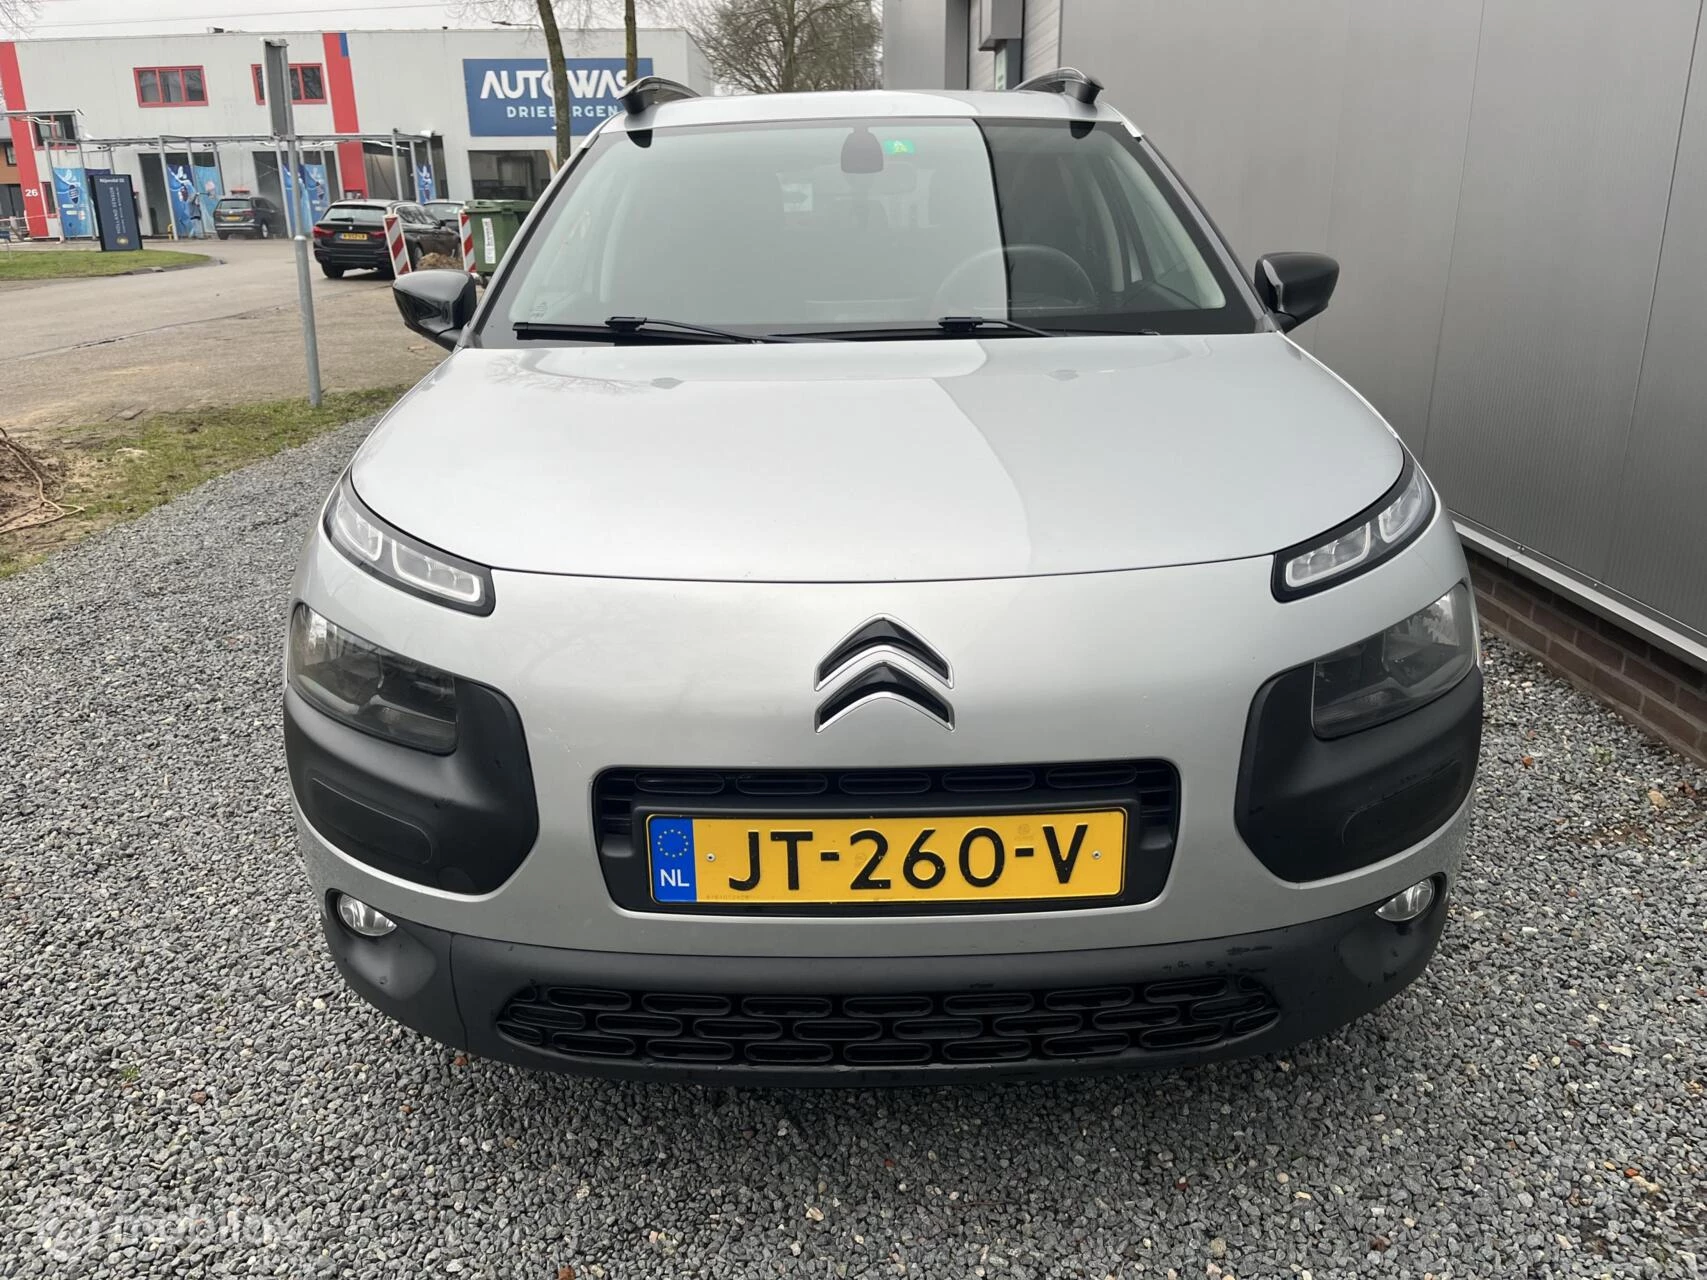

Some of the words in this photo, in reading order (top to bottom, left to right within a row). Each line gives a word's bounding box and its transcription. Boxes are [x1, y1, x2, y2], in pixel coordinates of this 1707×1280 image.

[506, 105, 618, 118] DRIEBRGEN
[24, 188, 39, 197] 26
[728, 824, 1089, 891] JT-260-V
[660, 869, 690, 887] NL
